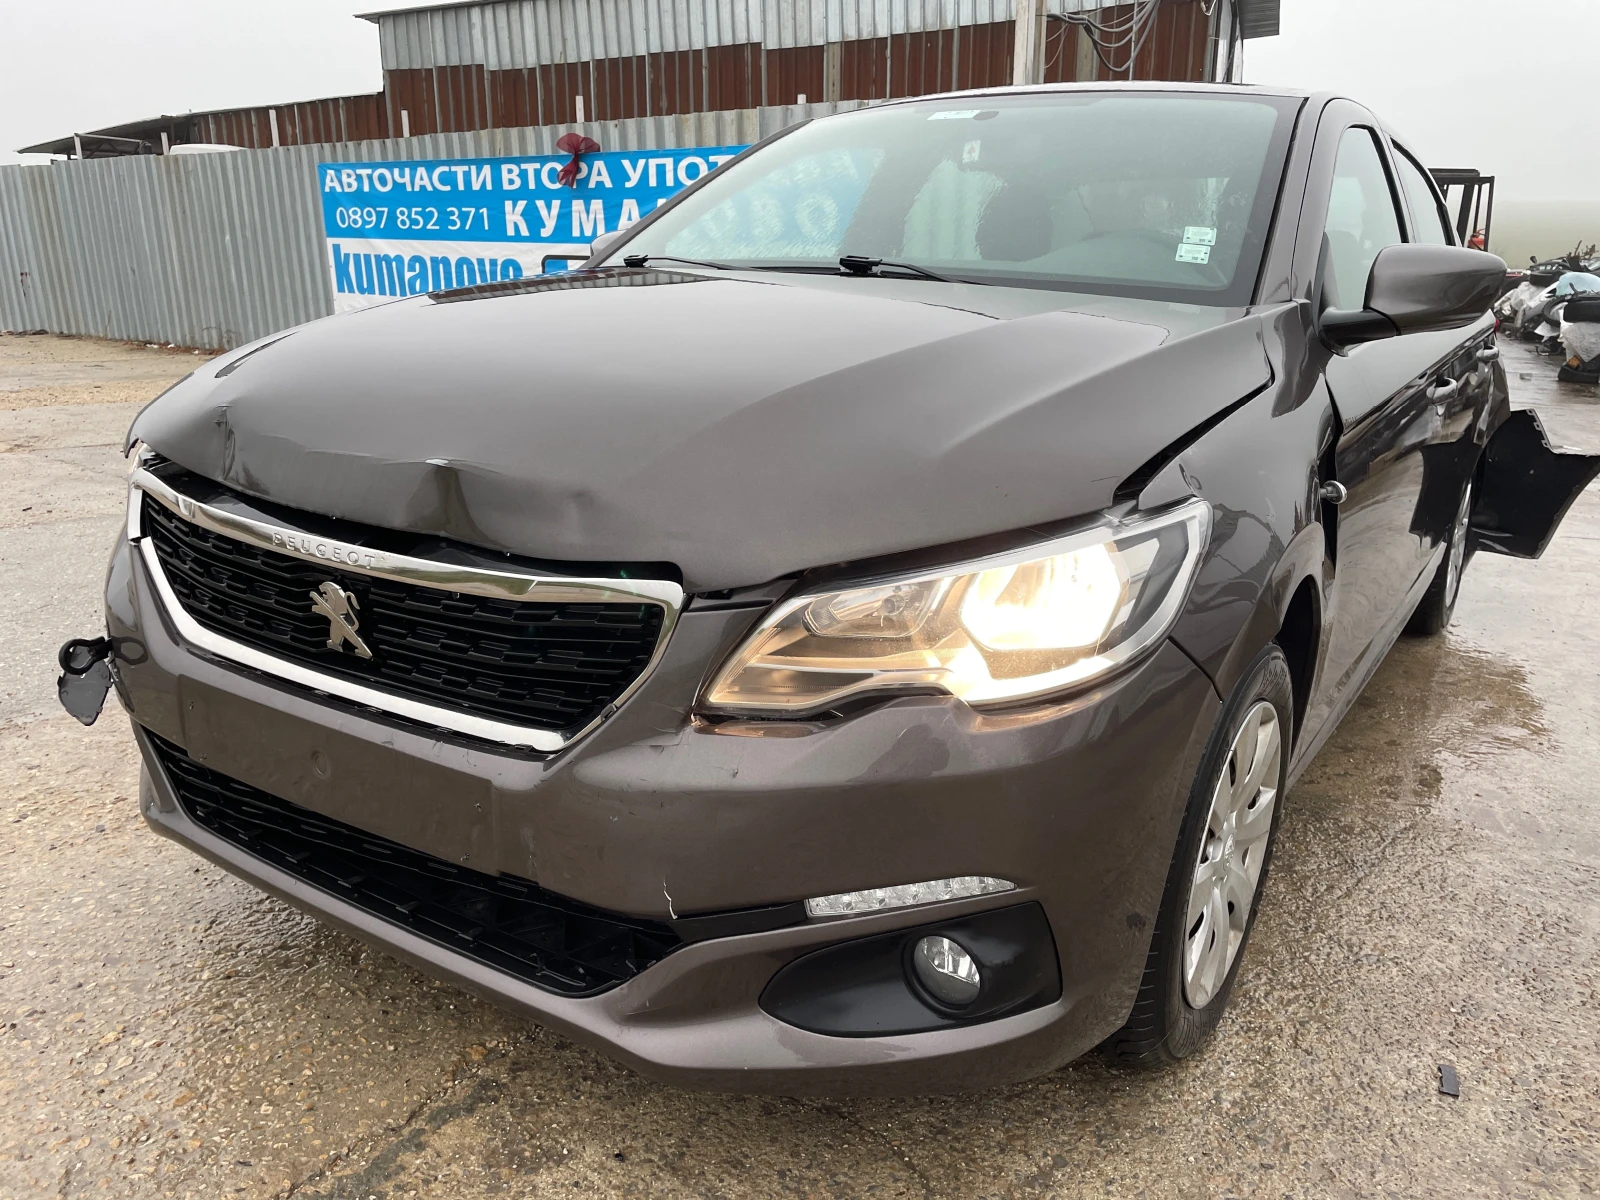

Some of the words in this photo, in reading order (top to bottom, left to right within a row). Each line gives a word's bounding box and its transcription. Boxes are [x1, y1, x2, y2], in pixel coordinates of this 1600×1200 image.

[324, 164, 493, 193] АВТОЧАСТИ
[501, 161, 613, 190] ВТОРА
[336, 206, 388, 229] 0897
[396, 207, 440, 230] 852
[446, 207, 490, 231] 371
[272, 532, 376, 570] PEUGEOT
